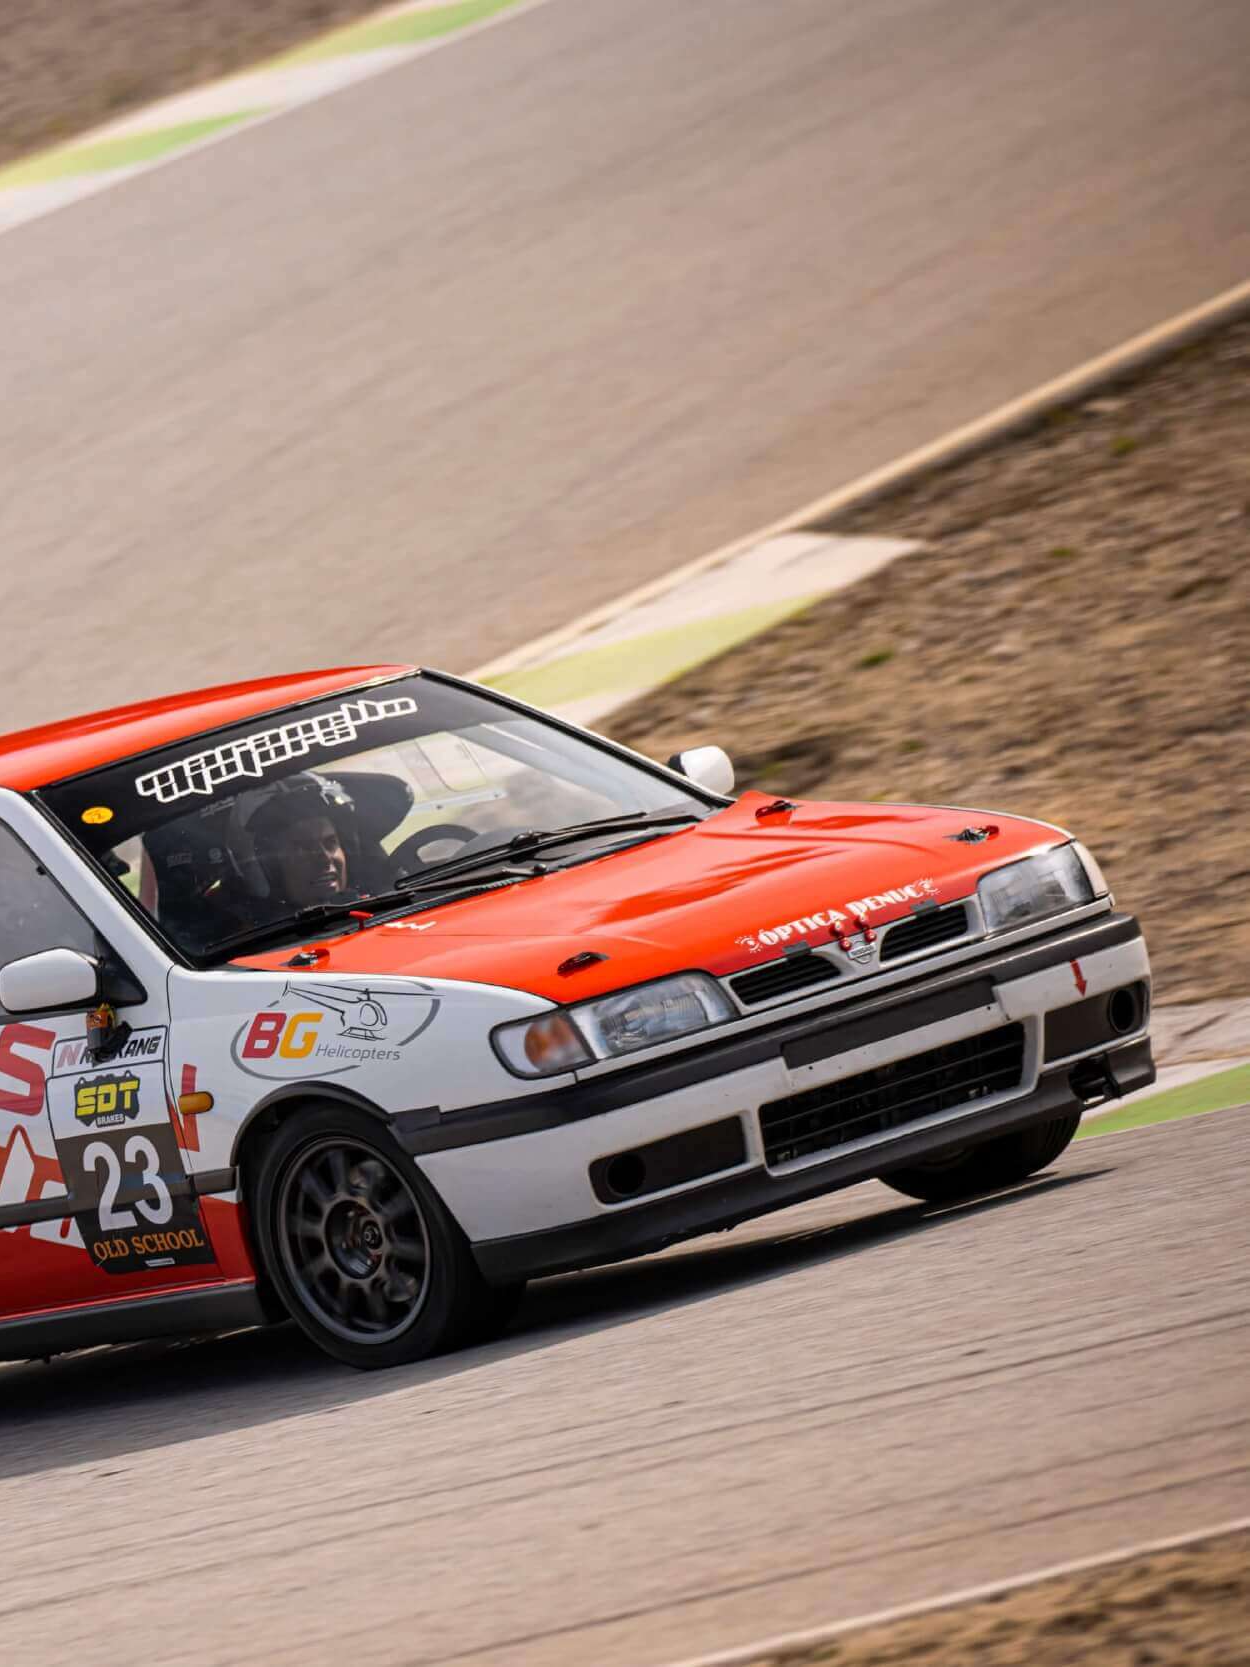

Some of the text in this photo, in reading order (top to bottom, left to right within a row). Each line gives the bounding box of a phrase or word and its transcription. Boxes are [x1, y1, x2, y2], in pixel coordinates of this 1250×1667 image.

[80, 1035, 162, 1066] NANG
[242, 1012, 401, 1062] BG Helicopters
[76, 1079, 140, 1118] SDT
[96, 1113, 125, 1126] BRAKES
[83, 1135, 173, 1232] 23
[93, 1229, 205, 1261] OLD SCHOOL
